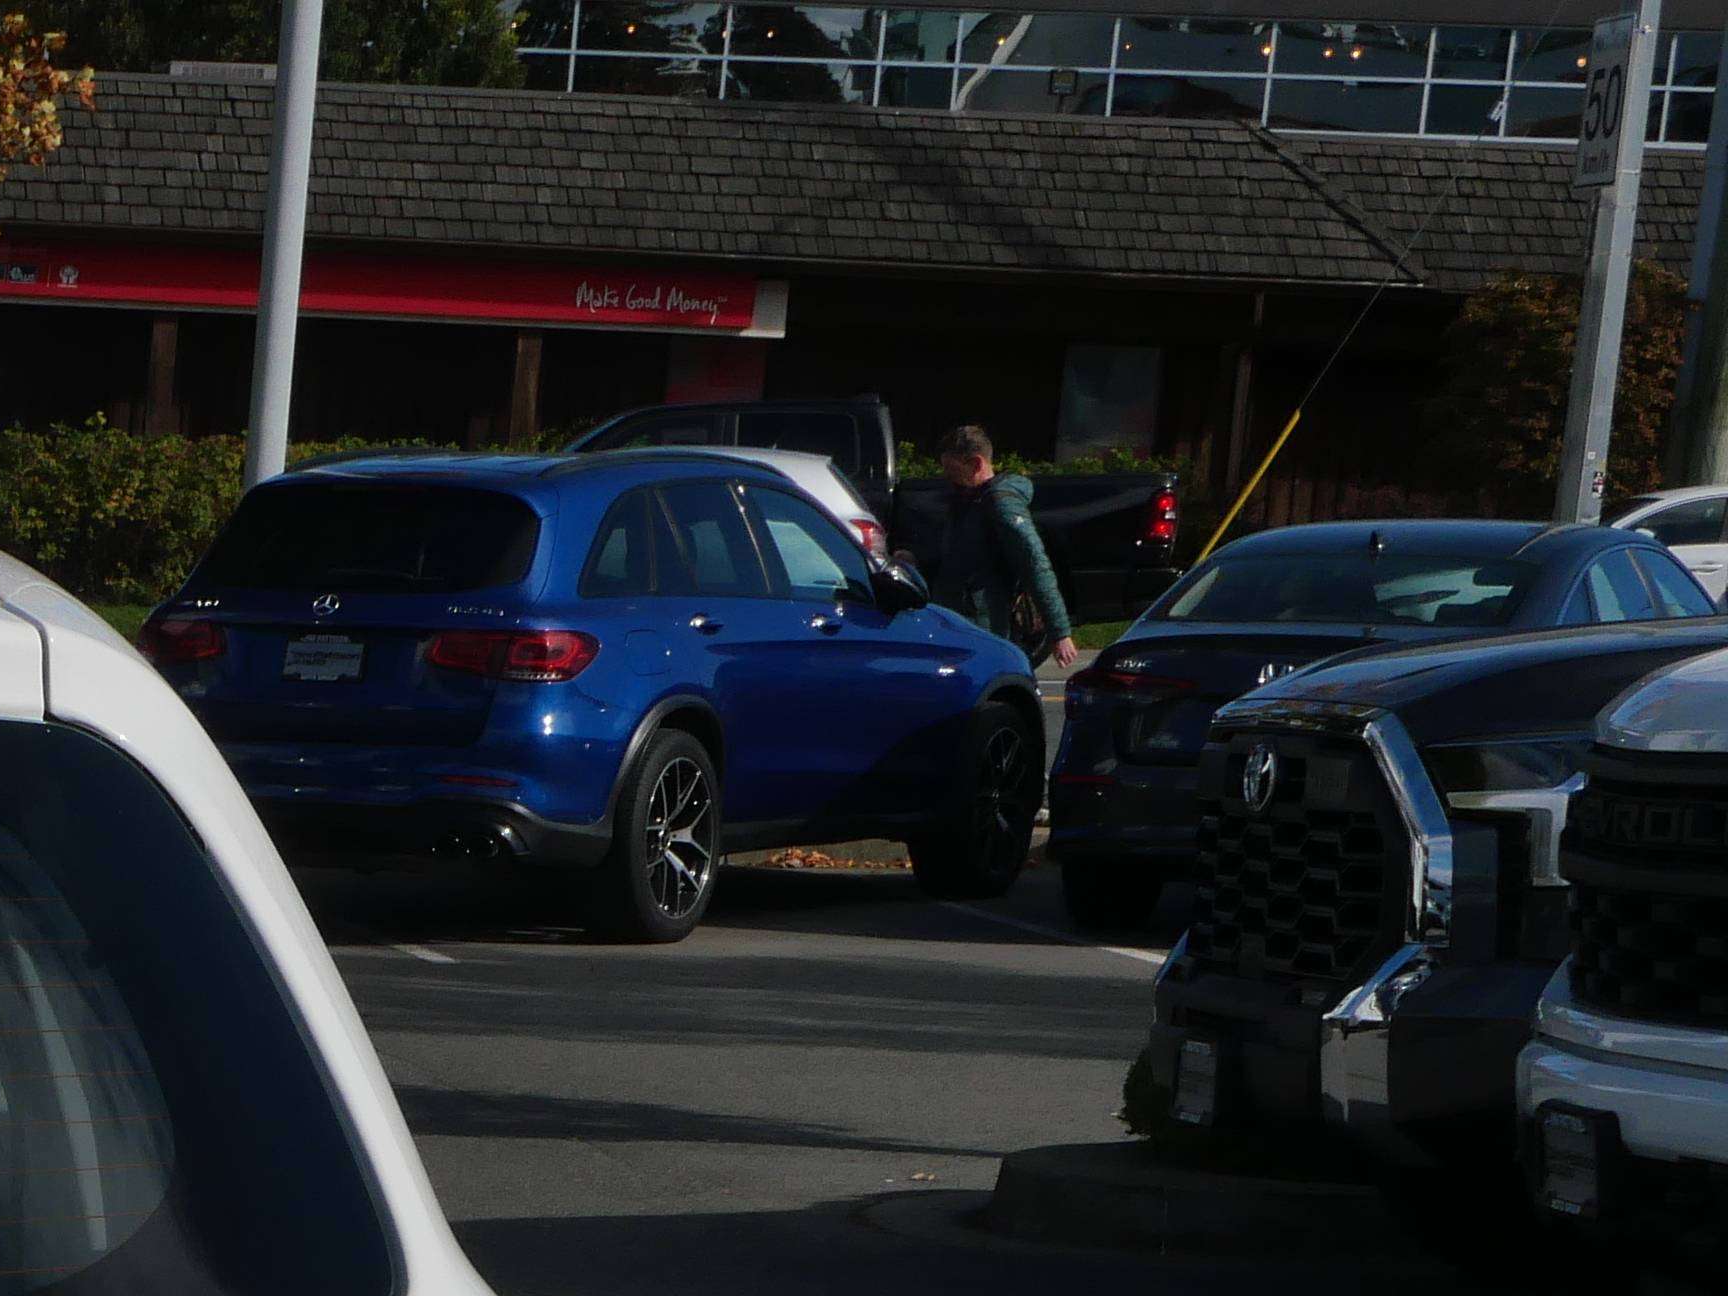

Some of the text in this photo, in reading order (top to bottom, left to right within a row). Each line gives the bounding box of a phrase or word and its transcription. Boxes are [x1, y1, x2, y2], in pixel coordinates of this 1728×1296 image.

[1584, 65, 1622, 141] 50
[575, 280, 620, 313] Make
[625, 283, 661, 310] Good
